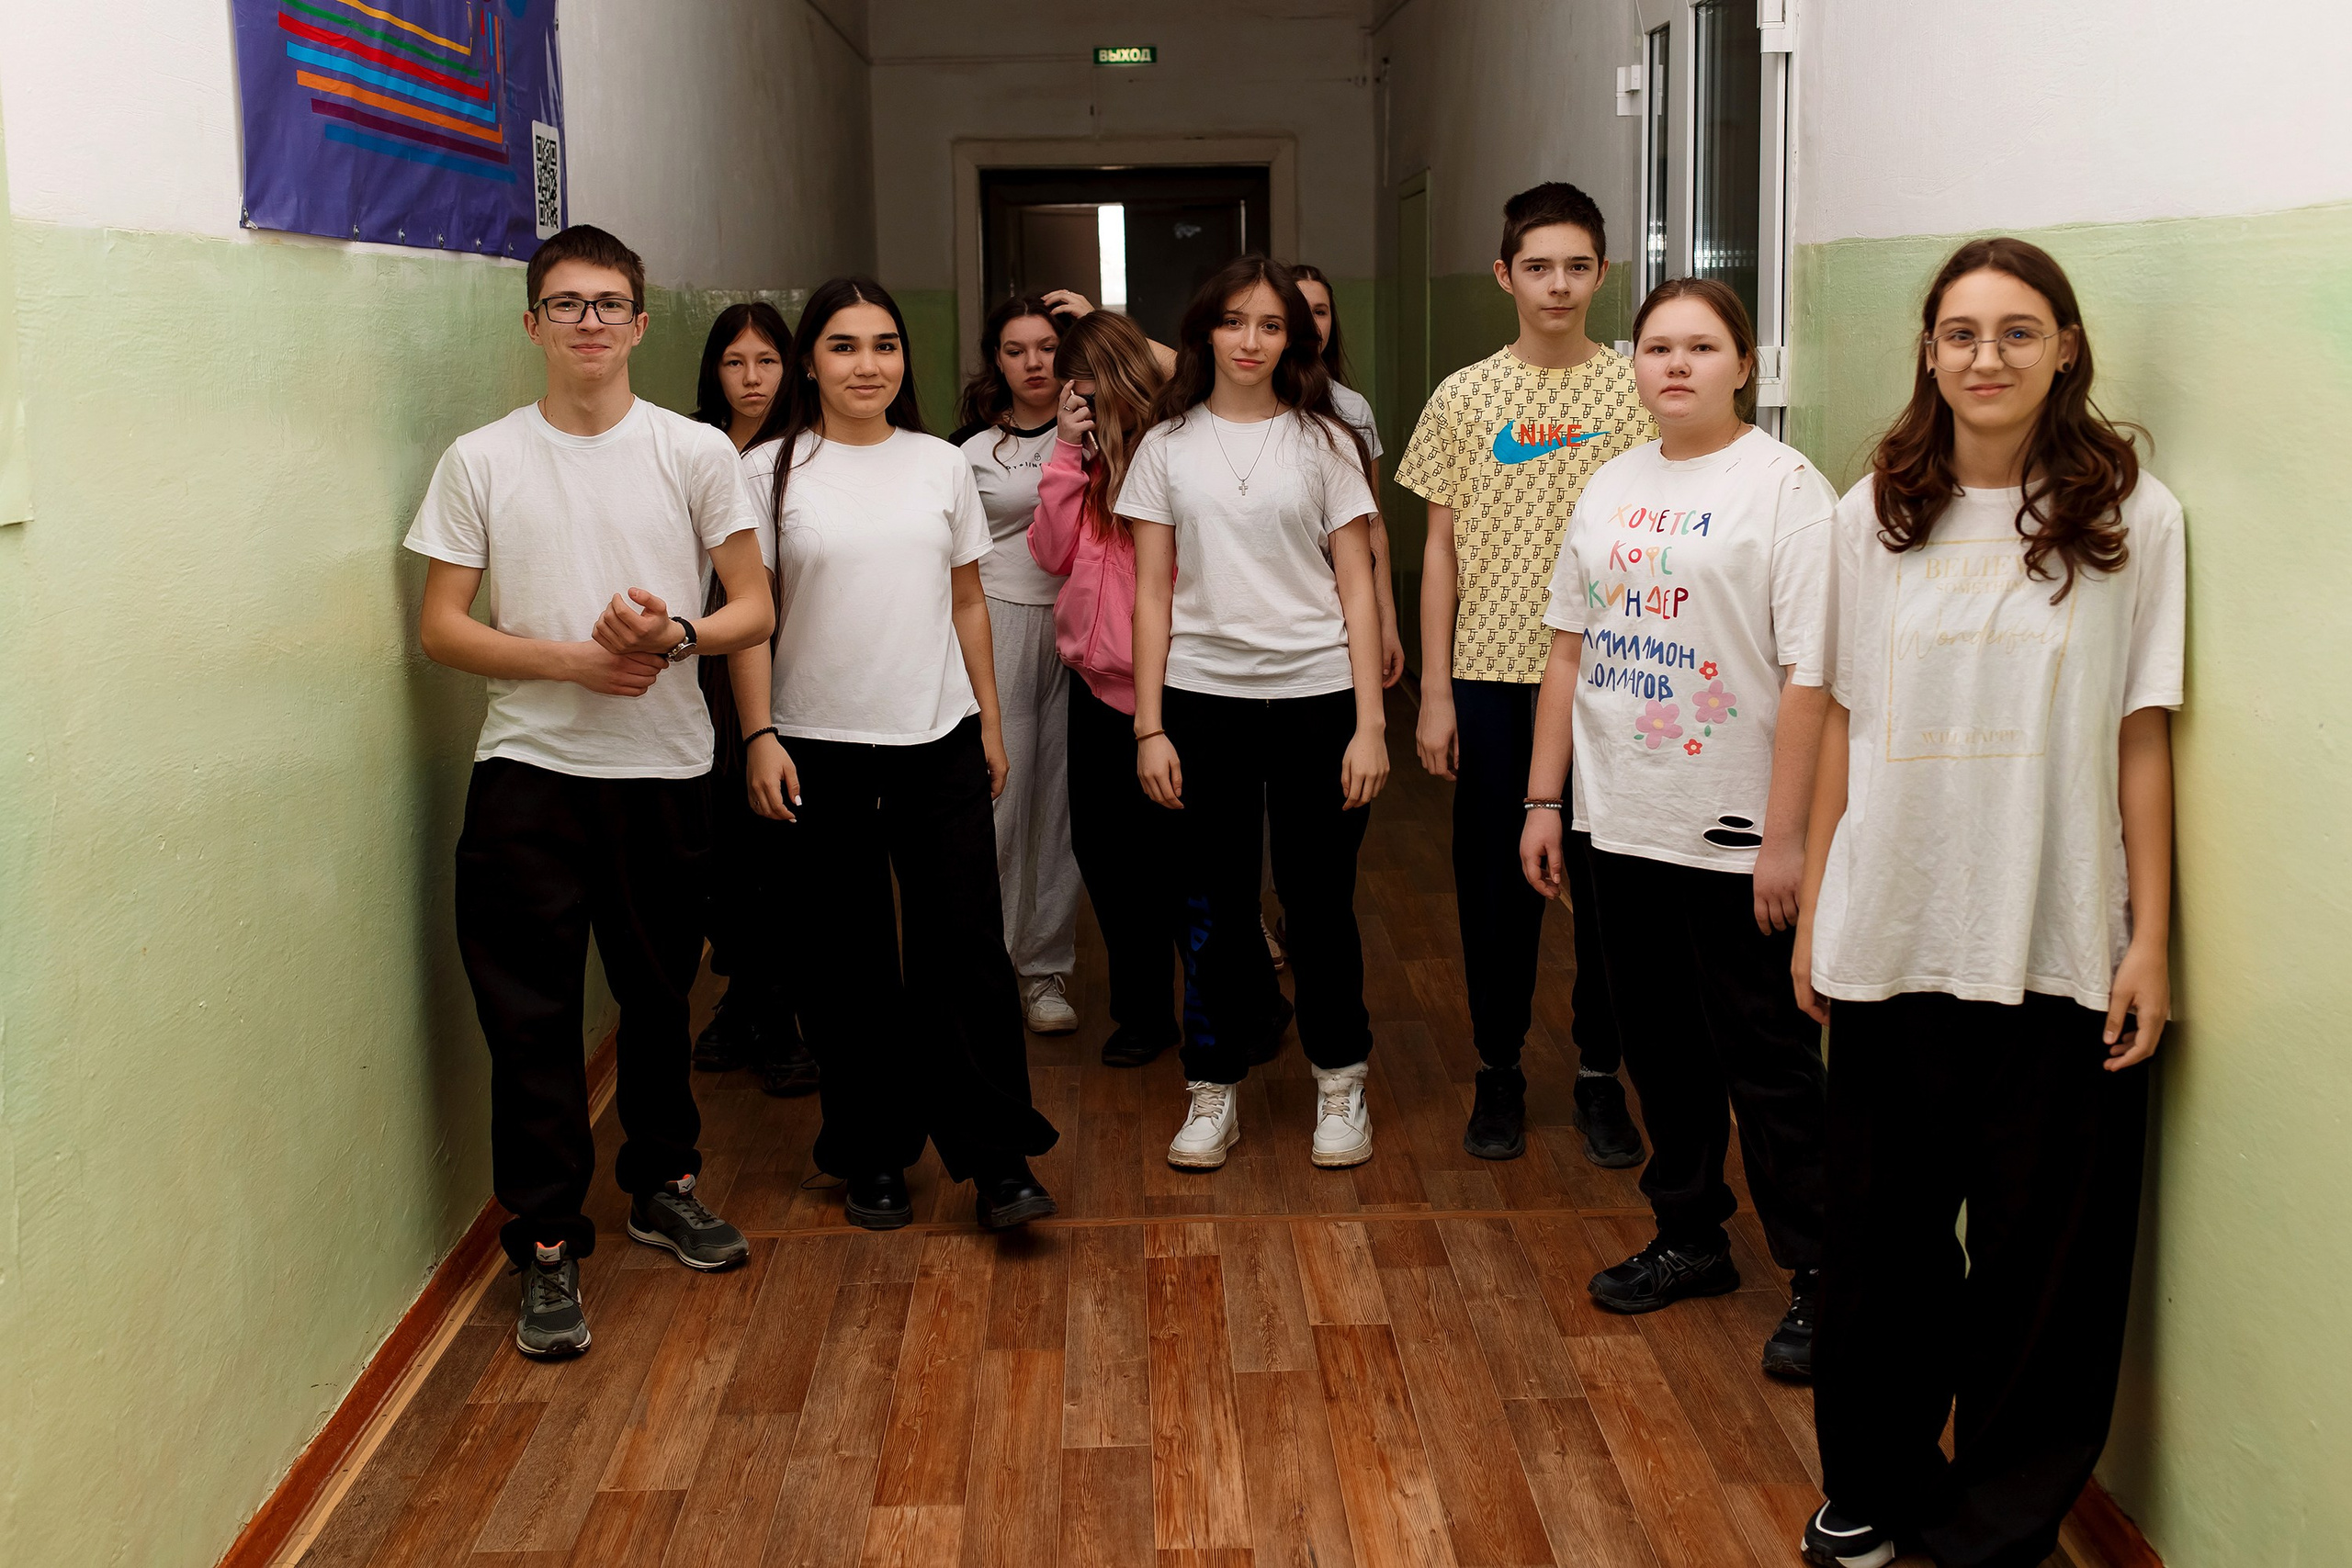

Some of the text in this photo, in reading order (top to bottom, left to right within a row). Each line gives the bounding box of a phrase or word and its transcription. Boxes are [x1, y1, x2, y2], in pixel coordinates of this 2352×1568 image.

[1099, 48, 1152, 62] ВЫХОД
[1520, 423, 1582, 447] NIKE
[1608, 503, 1712, 537] ХОЧЕТСЯ
[1589, 580, 1689, 620] КИНДЕР
